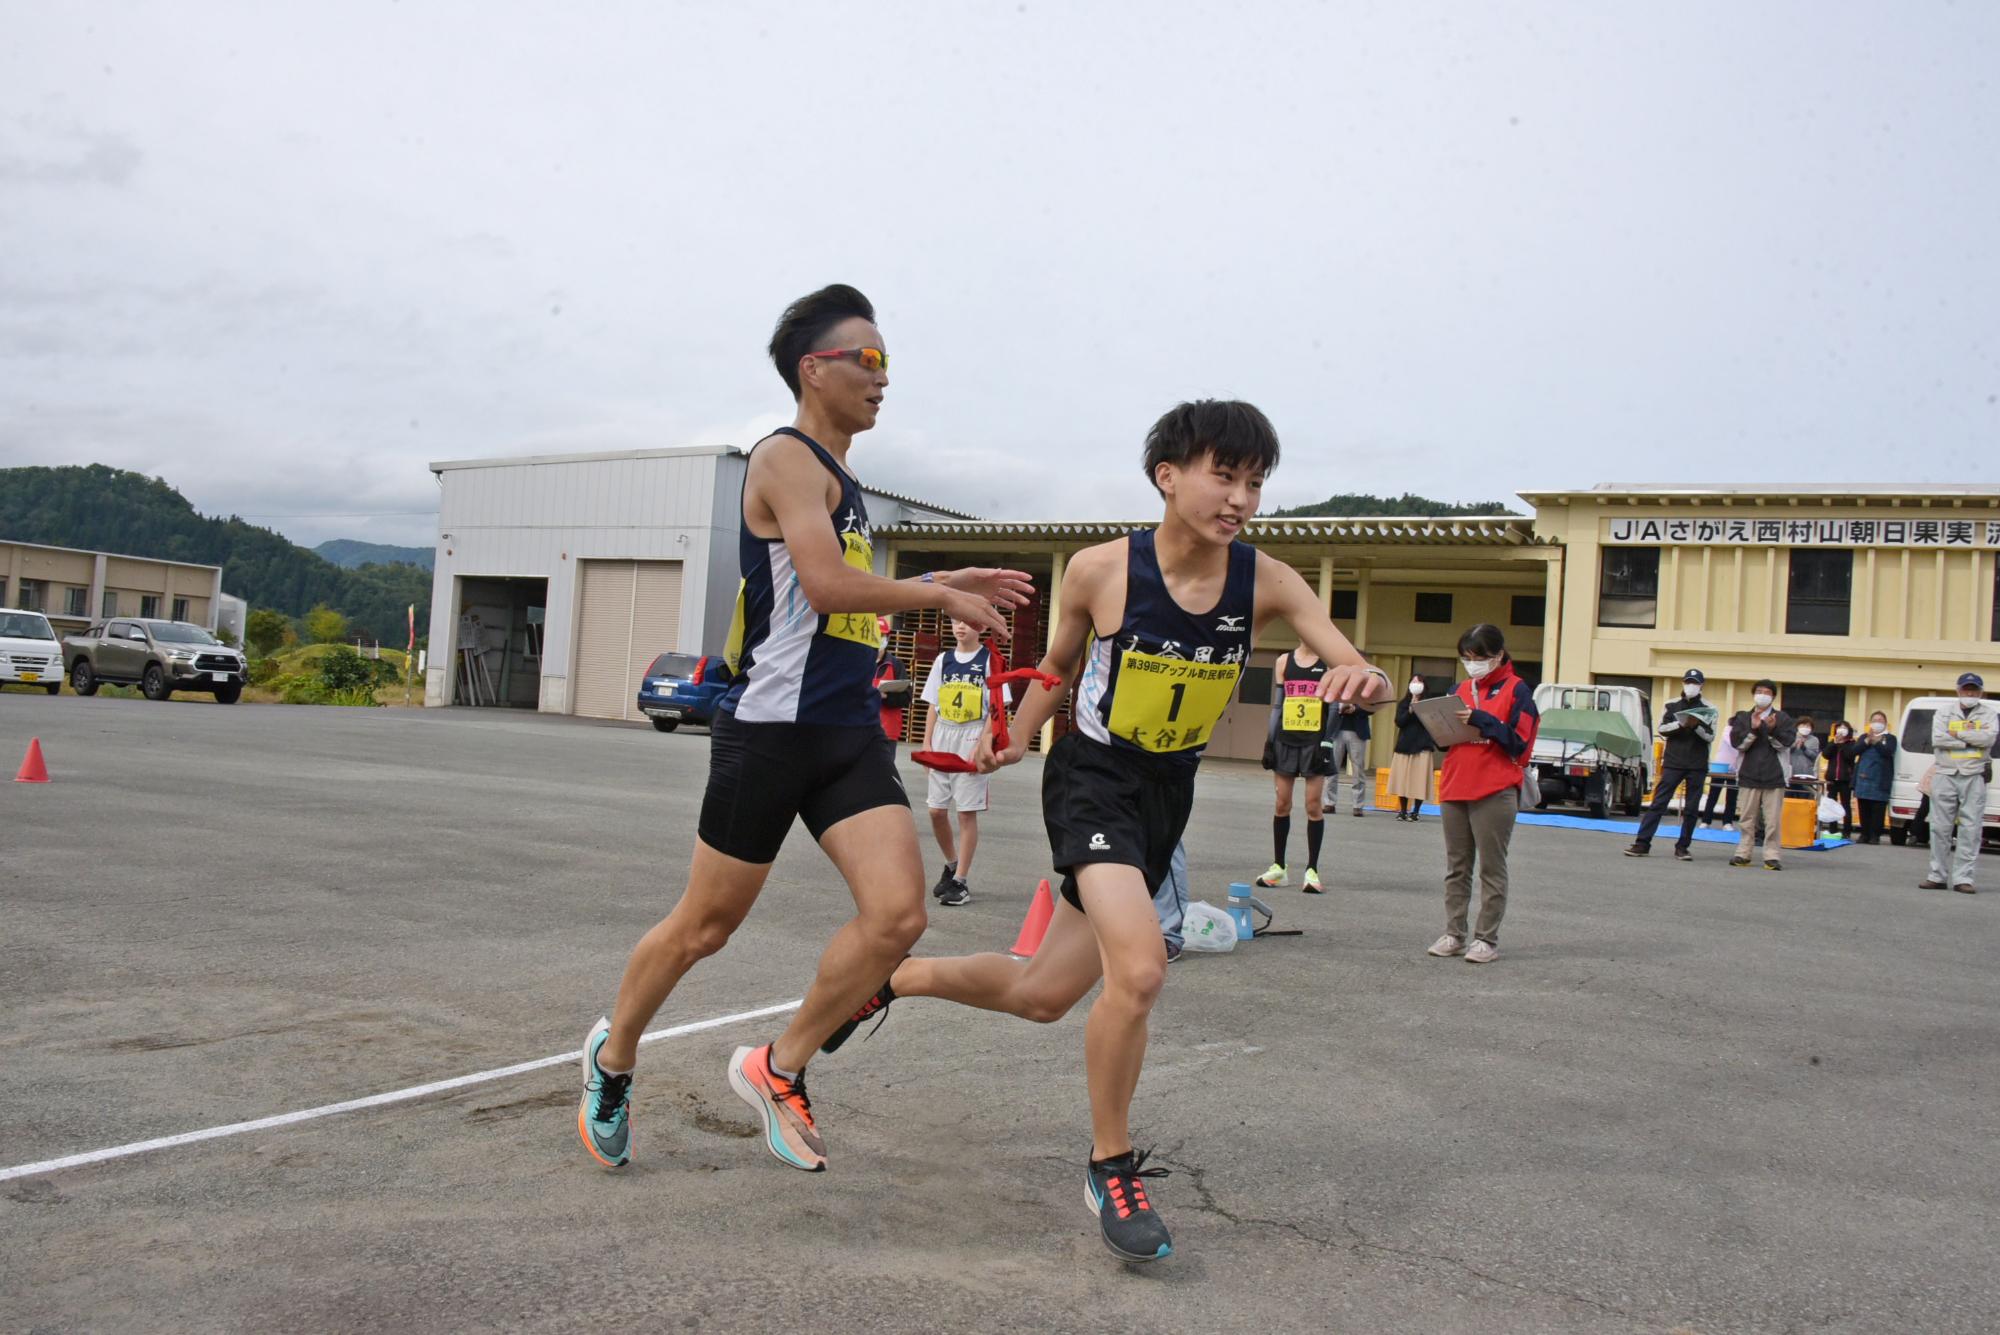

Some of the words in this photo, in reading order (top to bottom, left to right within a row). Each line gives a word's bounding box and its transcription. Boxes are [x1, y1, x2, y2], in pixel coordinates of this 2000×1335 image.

[1126, 657, 1236, 680] 第39回アップル町民駅伝
[952, 691, 963, 708] 4
[1167, 683, 1186, 722] 1
[1296, 703, 1305, 718] 3
